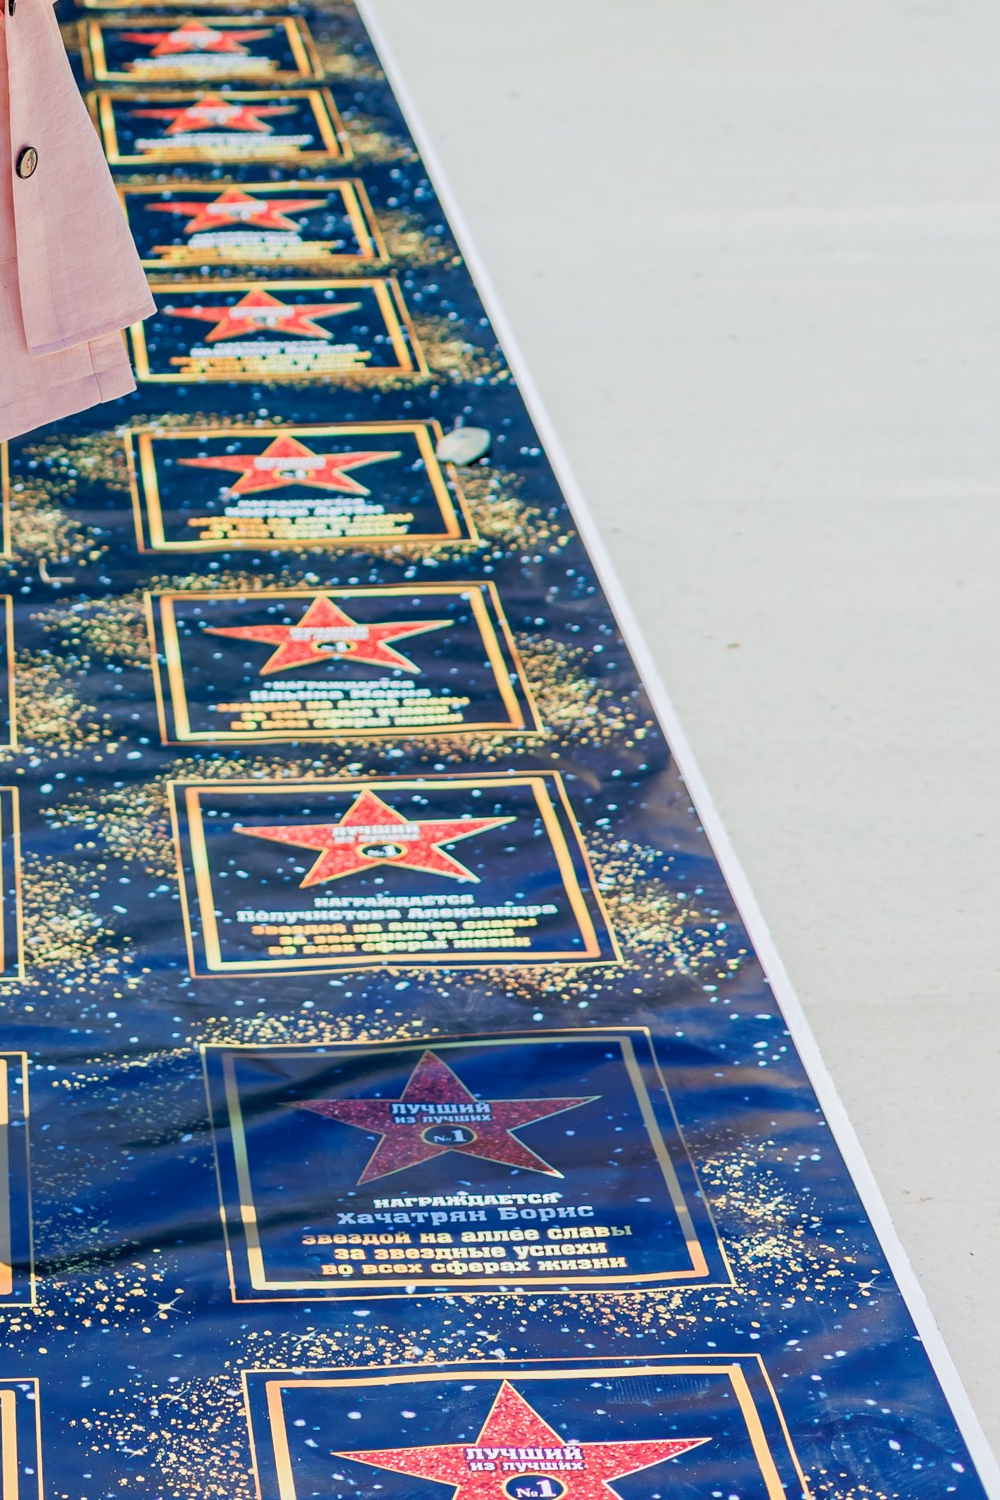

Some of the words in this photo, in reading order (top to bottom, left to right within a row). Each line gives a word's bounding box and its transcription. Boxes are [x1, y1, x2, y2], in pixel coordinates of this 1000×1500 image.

[391, 1101, 491, 1114] ЛУЧШИЙ
[394, 1115, 417, 1124] из
[421, 1113, 492, 1125] лучших
[433, 1128, 468, 1144] №1
[373, 1192, 561, 1209] НАГРАЖДАЕТСЯ
[337, 1209, 488, 1226] Хачатрян
[498, 1205, 595, 1223] Борис
[302, 1231, 412, 1247] звездой
[420, 1231, 453, 1244] на
[461, 1228, 540, 1243] аллее
[546, 1223, 633, 1240] славы
[334, 1247, 367, 1261] за
[374, 1245, 507, 1261] звездные
[512, 1241, 609, 1260] успехи
[321, 1263, 354, 1276] во
[361, 1262, 424, 1275] всех
[430, 1258, 531, 1276] сферах
[538, 1256, 628, 1271] жизни
[465, 1445, 584, 1460] ЛУЧШИЙ
[469, 1461, 496, 1471] из
[502, 1461, 585, 1473] лучших
[515, 1479, 557, 1498] №1
